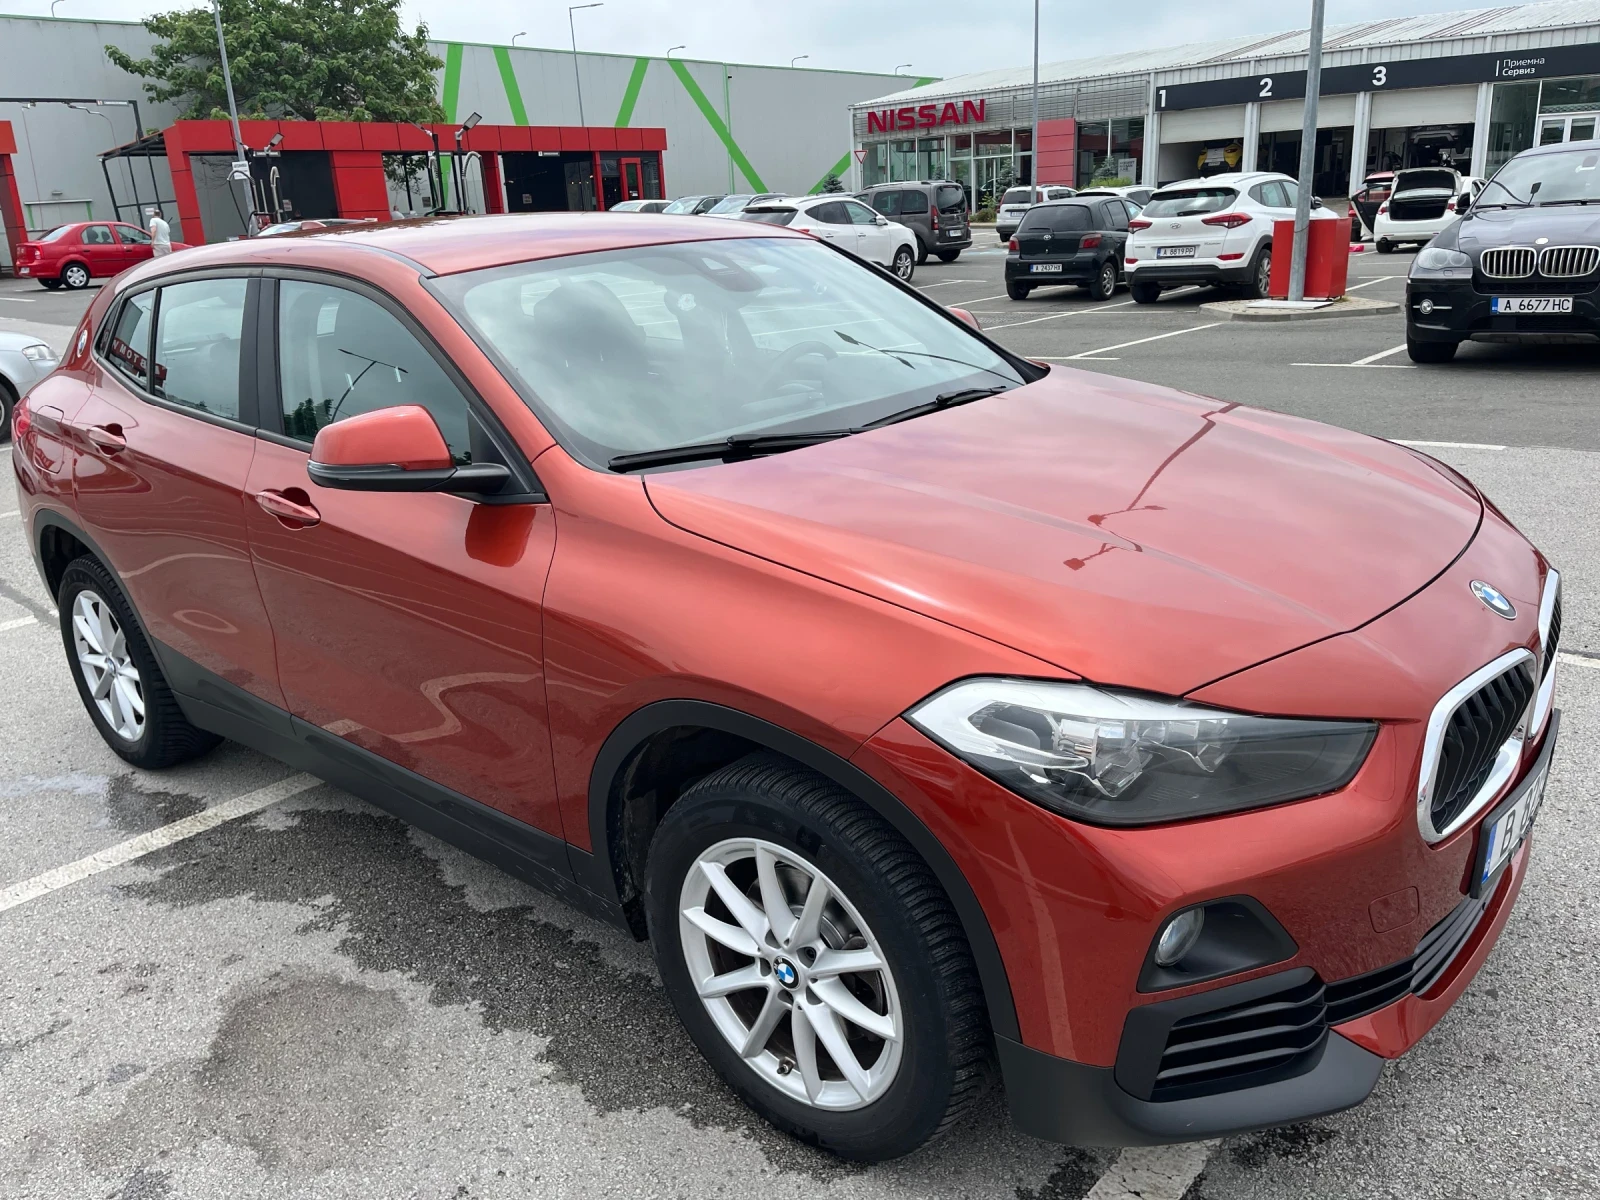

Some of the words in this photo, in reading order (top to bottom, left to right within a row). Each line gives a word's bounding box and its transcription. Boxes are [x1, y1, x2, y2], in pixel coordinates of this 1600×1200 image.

[1502, 67, 1536, 77] Сервиз
[1503, 57, 1546, 68] Приемна
[1371, 65, 1388, 87] 3
[1258, 77, 1273, 98] 2
[1158, 89, 1167, 108] 1
[867, 98, 987, 134] NISSAN
[1504, 299, 1512, 311] A
[1519, 299, 1550, 311] 6677
[1499, 809, 1516, 858] B
